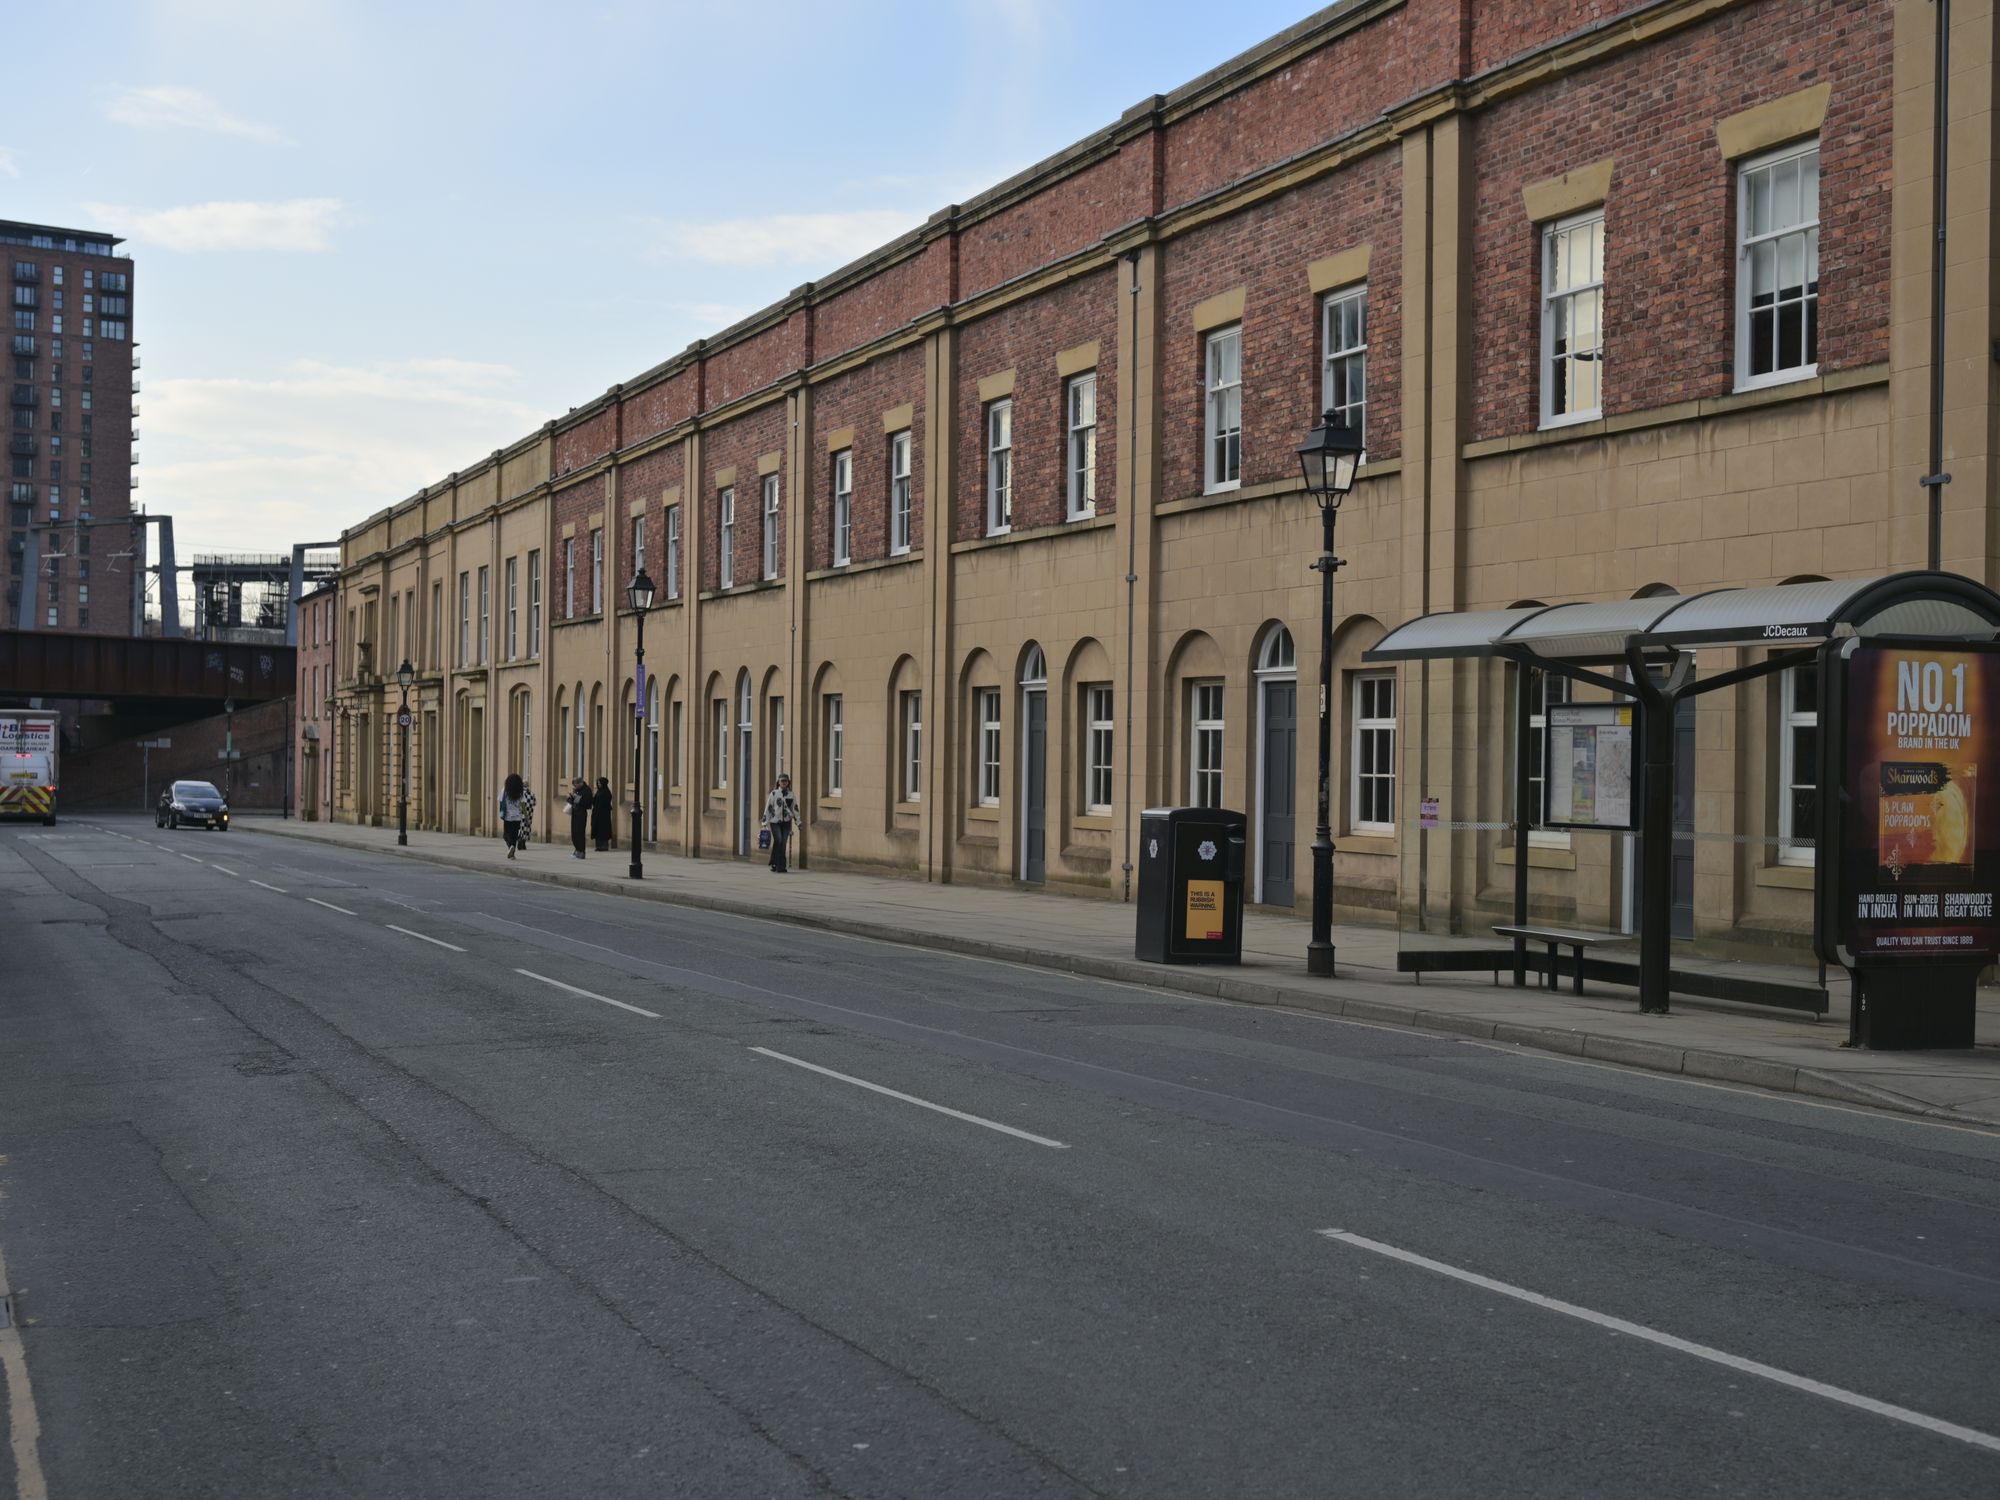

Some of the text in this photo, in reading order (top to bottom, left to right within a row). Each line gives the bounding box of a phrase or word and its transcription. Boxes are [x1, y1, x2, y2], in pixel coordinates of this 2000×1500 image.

[1763, 625, 1808, 637] JCDecaux
[1897, 660, 1964, 713] NO.1
[1887, 711, 1971, 737] POPPADOM
[1898, 737, 1960, 750] BRAND IN THE UK
[1887, 767, 1939, 785] Sharwood's
[1884, 814, 1931, 828] POPPADOMS
[1858, 893, 1898, 903] HAND ROLLED
[1904, 894, 1939, 904] SUN-DRIED
[1944, 893, 1992, 905] SHARWOOD'S
[1858, 903, 1898, 918] IN INDIA
[1903, 904, 1939, 918] IN INDIA
[1944, 905, 1992, 918] GREAT TASTE
[1876, 936, 1899, 947] QUALITY
[1900, 936, 1911, 946] YOU
[1912, 936, 1924, 946] CAN
[1924, 936, 1942, 945] TRUST
[1942, 936, 1959, 945] SINCE
